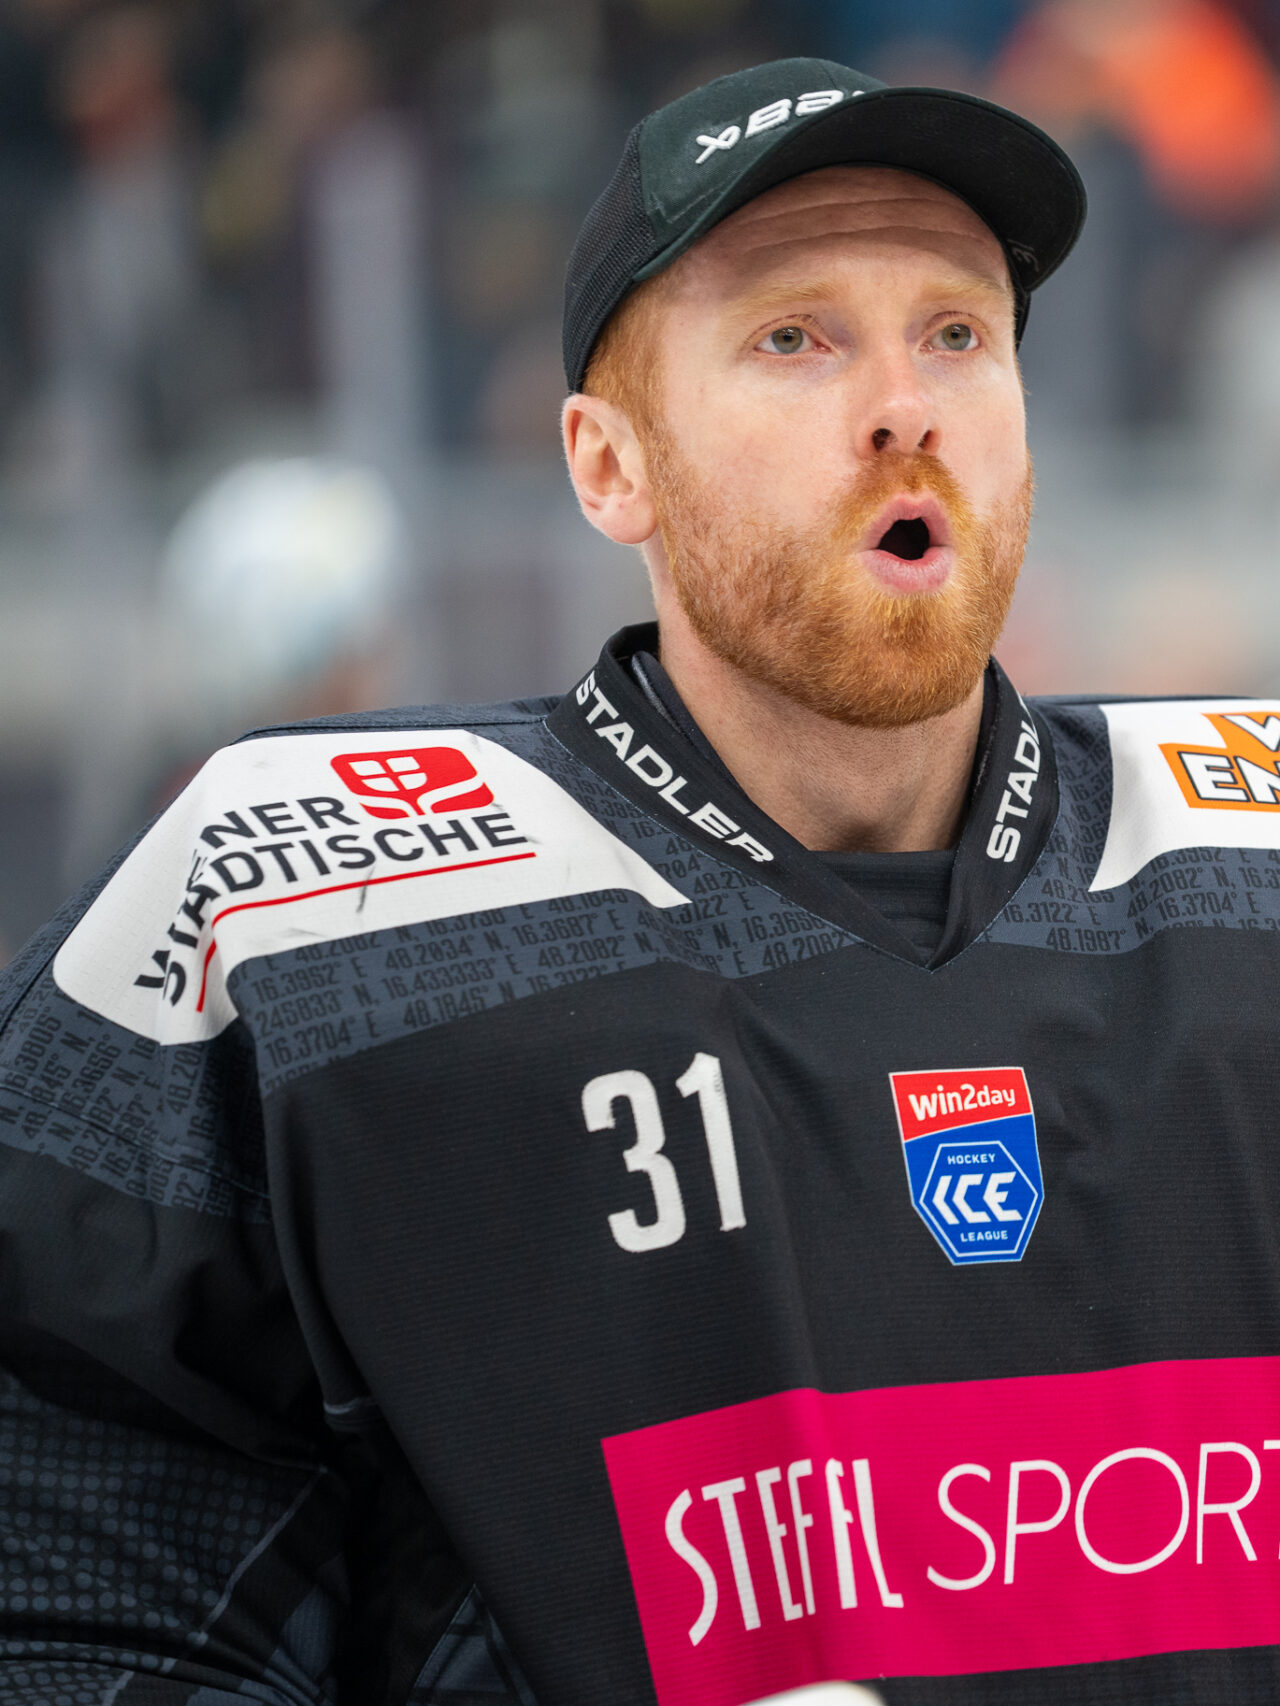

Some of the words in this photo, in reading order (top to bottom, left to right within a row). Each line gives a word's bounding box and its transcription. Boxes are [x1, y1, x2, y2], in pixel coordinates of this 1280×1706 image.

[576, 671, 774, 862] STADLER
[986, 690, 1041, 862] STADL
[581, 1052, 746, 1253] 31
[932, 1171, 1023, 1225] ICE
[947, 1153, 996, 1165] HOCKEY
[960, 1230, 1008, 1242] LEAGUE
